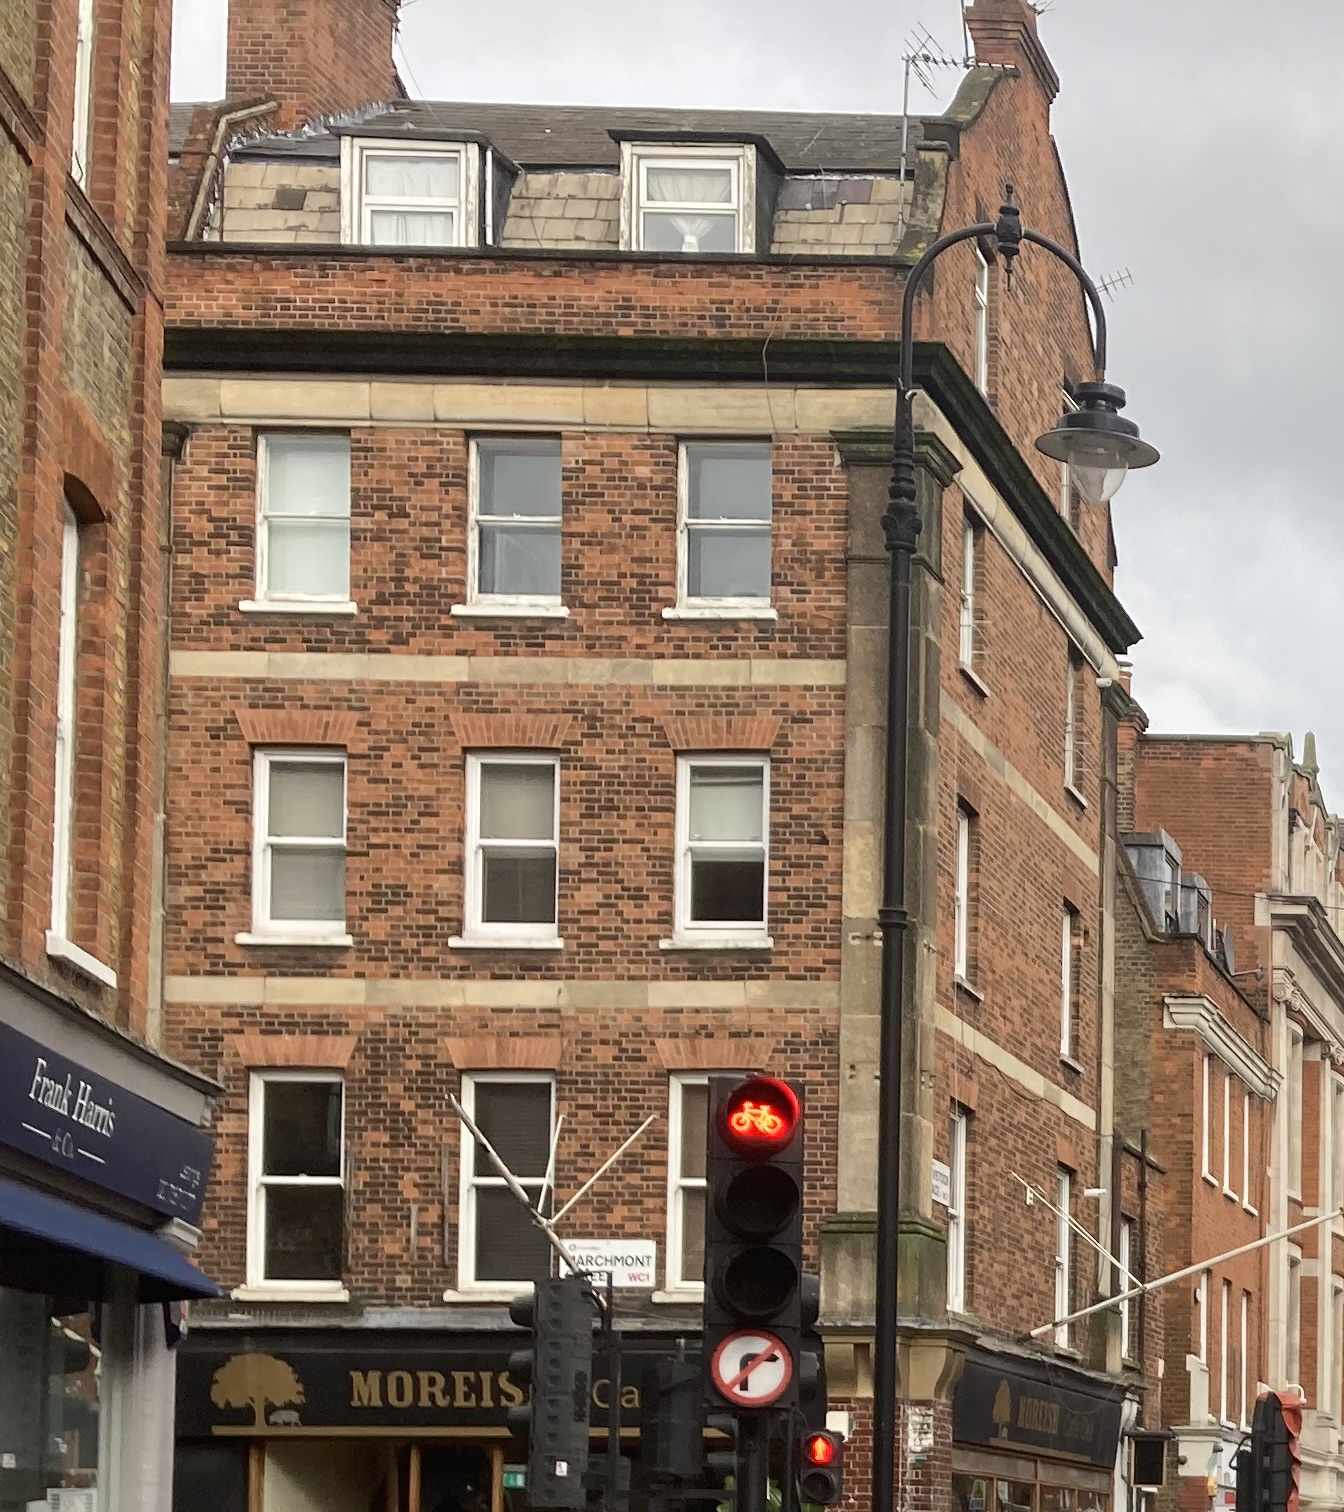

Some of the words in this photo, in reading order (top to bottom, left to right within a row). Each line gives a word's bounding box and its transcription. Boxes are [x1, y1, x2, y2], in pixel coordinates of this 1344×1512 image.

[28, 1057, 72, 1118] Frank
[72, 1080, 116, 1138] Harris
[627, 1272, 650, 1282] WC1
[350, 1370, 531, 1408] MOREIS
